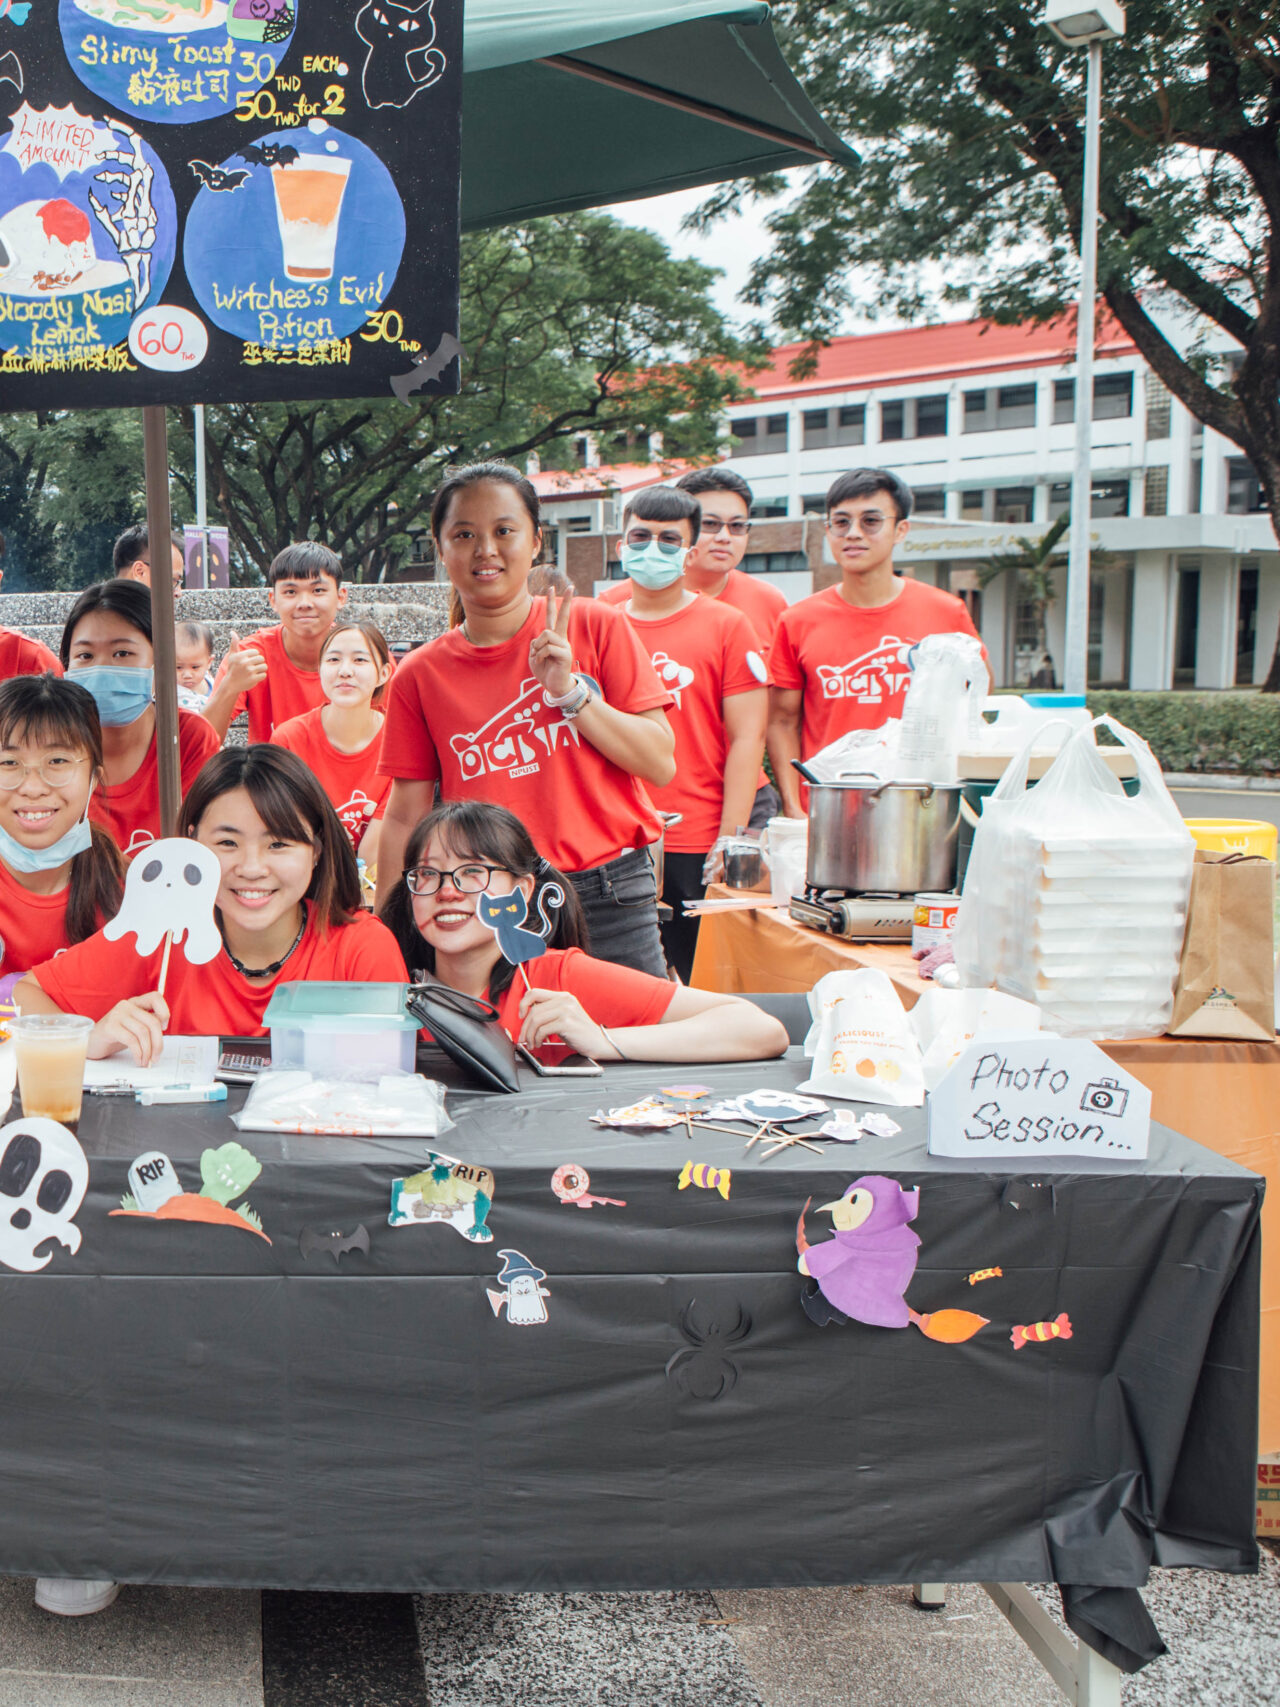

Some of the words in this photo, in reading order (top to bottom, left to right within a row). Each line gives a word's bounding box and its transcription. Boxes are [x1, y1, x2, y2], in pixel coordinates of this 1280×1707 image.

[79, 35, 157, 77] Slimy
[168, 36, 236, 65] Toast
[236, 52, 275, 83] 30
[275, 75, 301, 92] TWD
[303, 56, 339, 73] EACH
[235, 90, 276, 122] 50
[274, 111, 300, 127] TWD
[293, 94, 321, 117] for
[322, 84, 346, 115] 2
[20, 143, 90, 168] AMOUNT
[83, 287, 133, 317] Nasi
[339, 272, 384, 305] Evil
[138, 321, 183, 356] 60
[181, 352, 196, 361] TWD
[258, 311, 335, 340] Potion
[360, 309, 403, 343] 30
[398, 340, 421, 353] TWD
[903, 537, 984, 553] Department
[988, 534, 1004, 547] of
[511, 765, 538, 777] NPUST
[971, 1052, 1069, 1094] Photo
[136, 1158, 165, 1185] RIP
[456, 1165, 487, 1182] RIP
